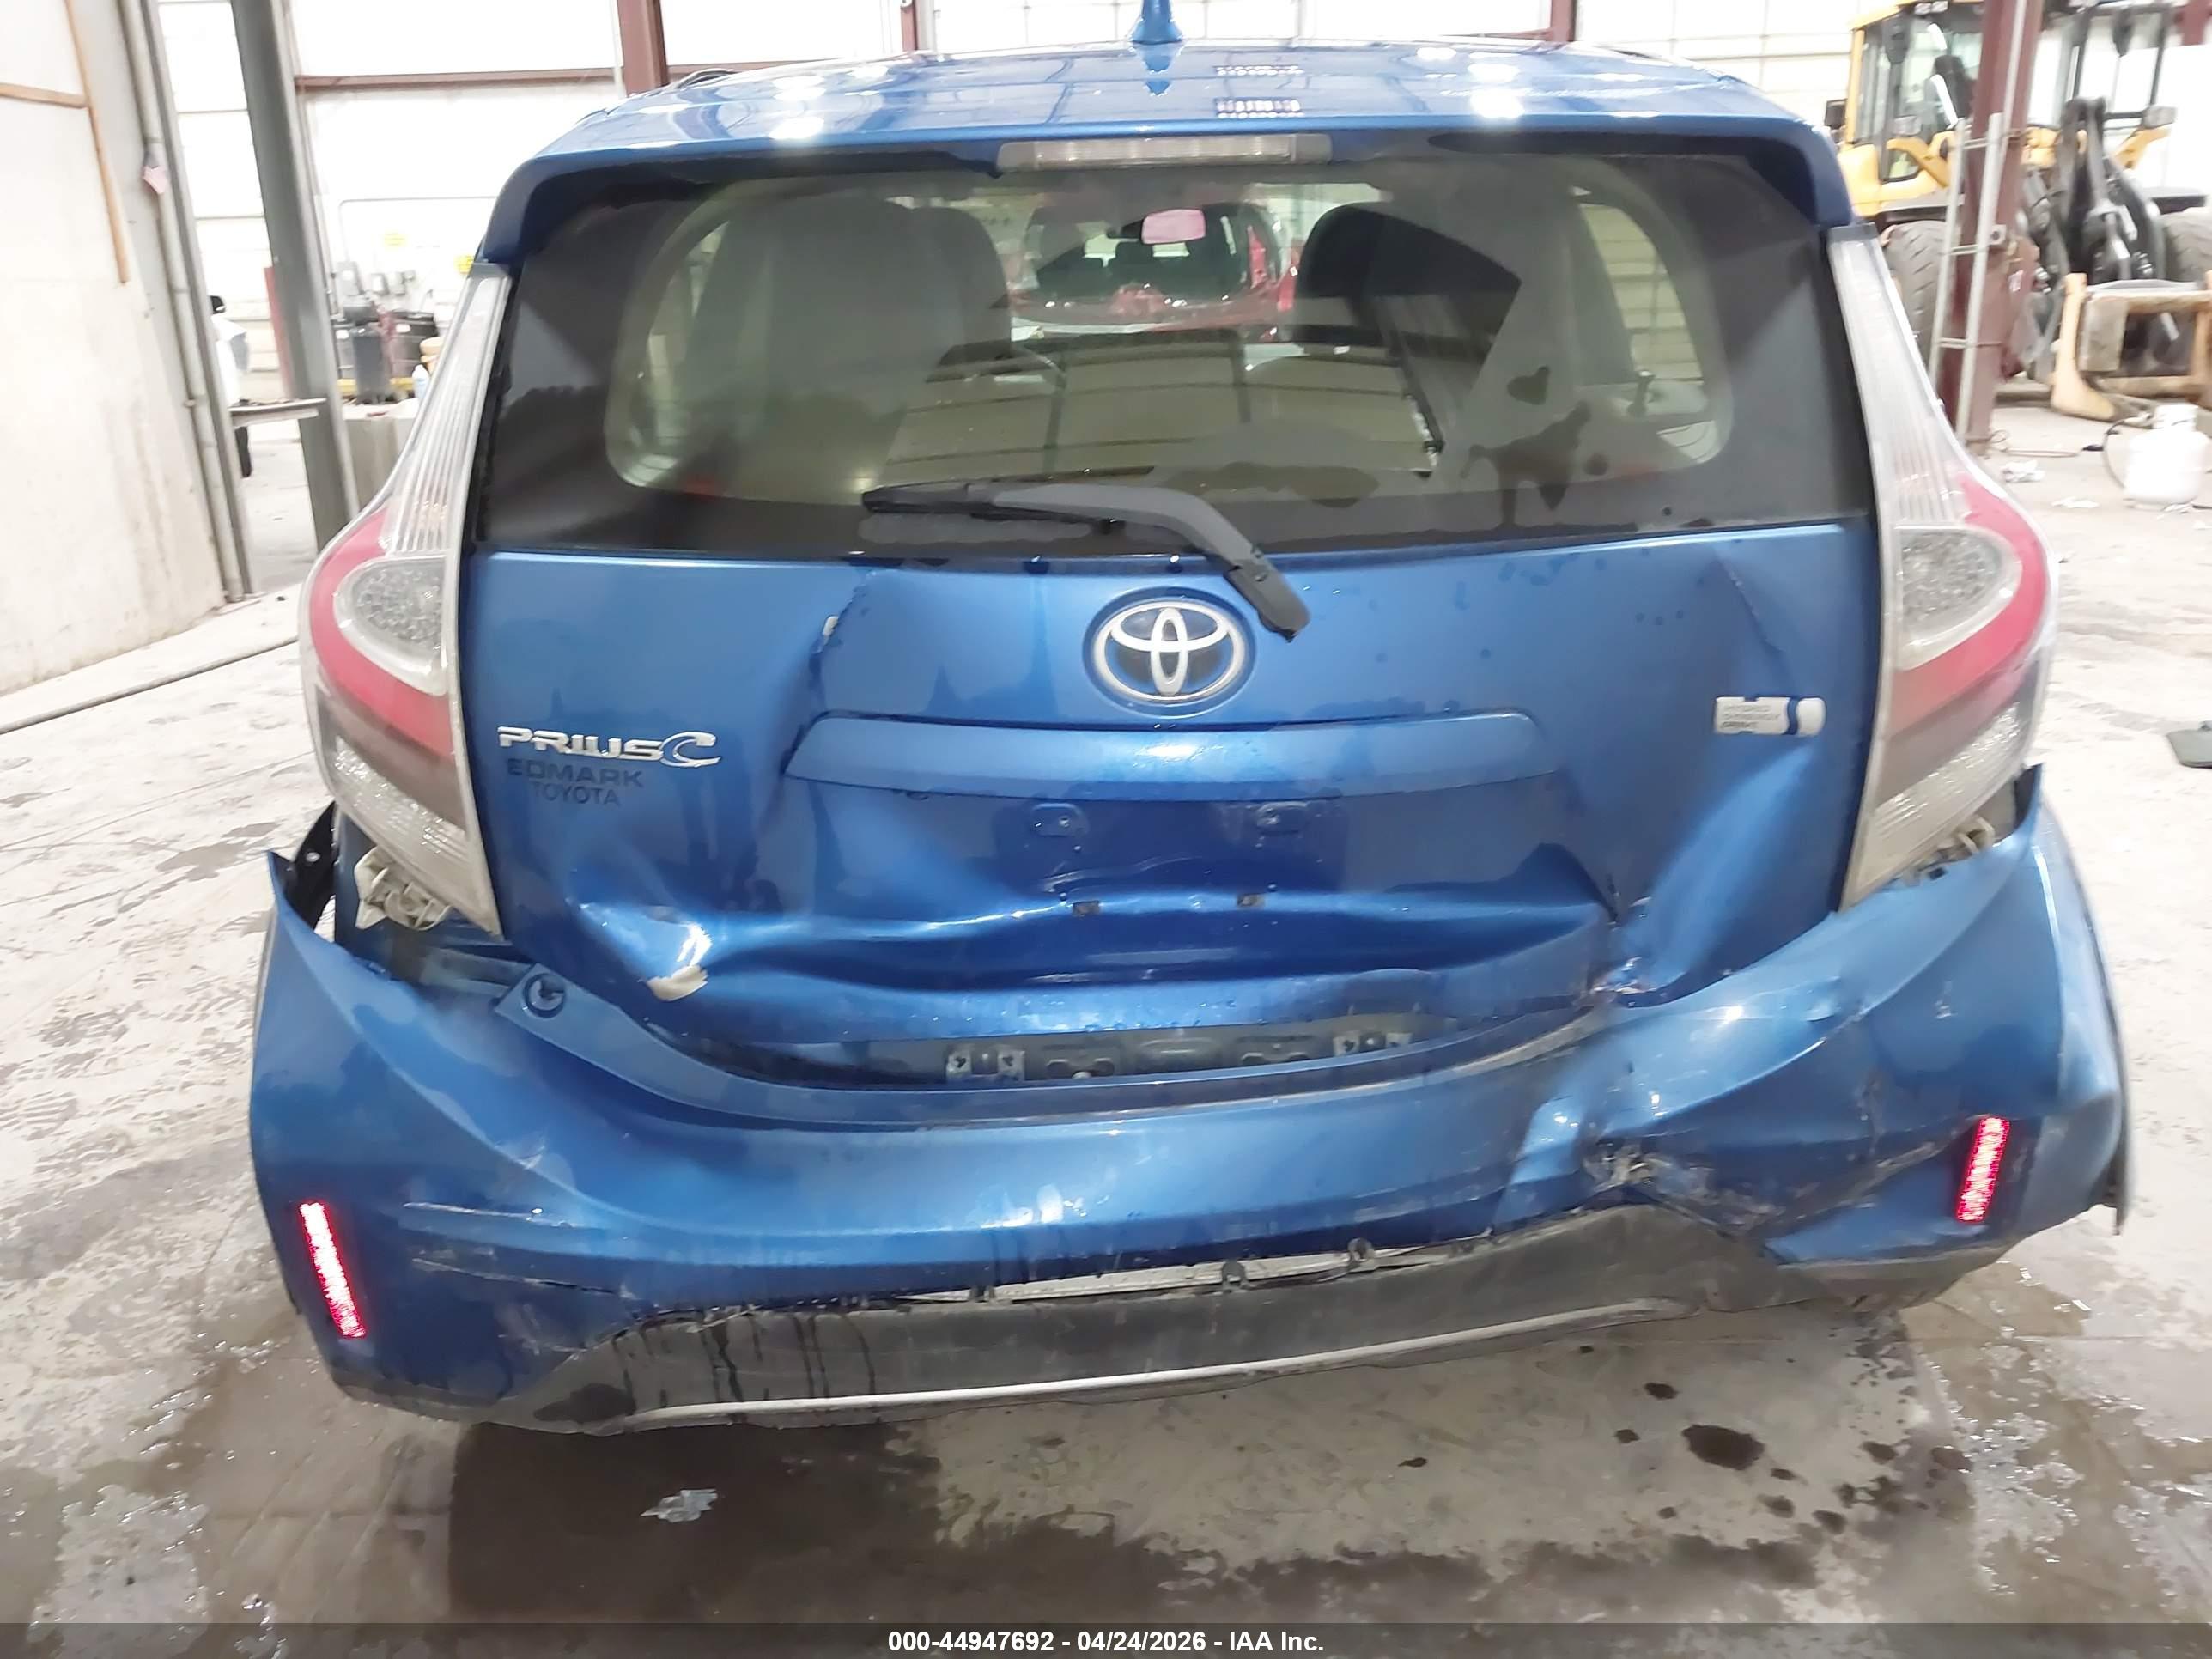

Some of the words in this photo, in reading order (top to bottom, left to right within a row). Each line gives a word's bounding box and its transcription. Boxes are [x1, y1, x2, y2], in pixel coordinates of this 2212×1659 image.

[497, 726, 664, 761] PRIUS
[507, 758, 643, 787] EDMARK
[532, 781, 620, 806] TOYOTA
